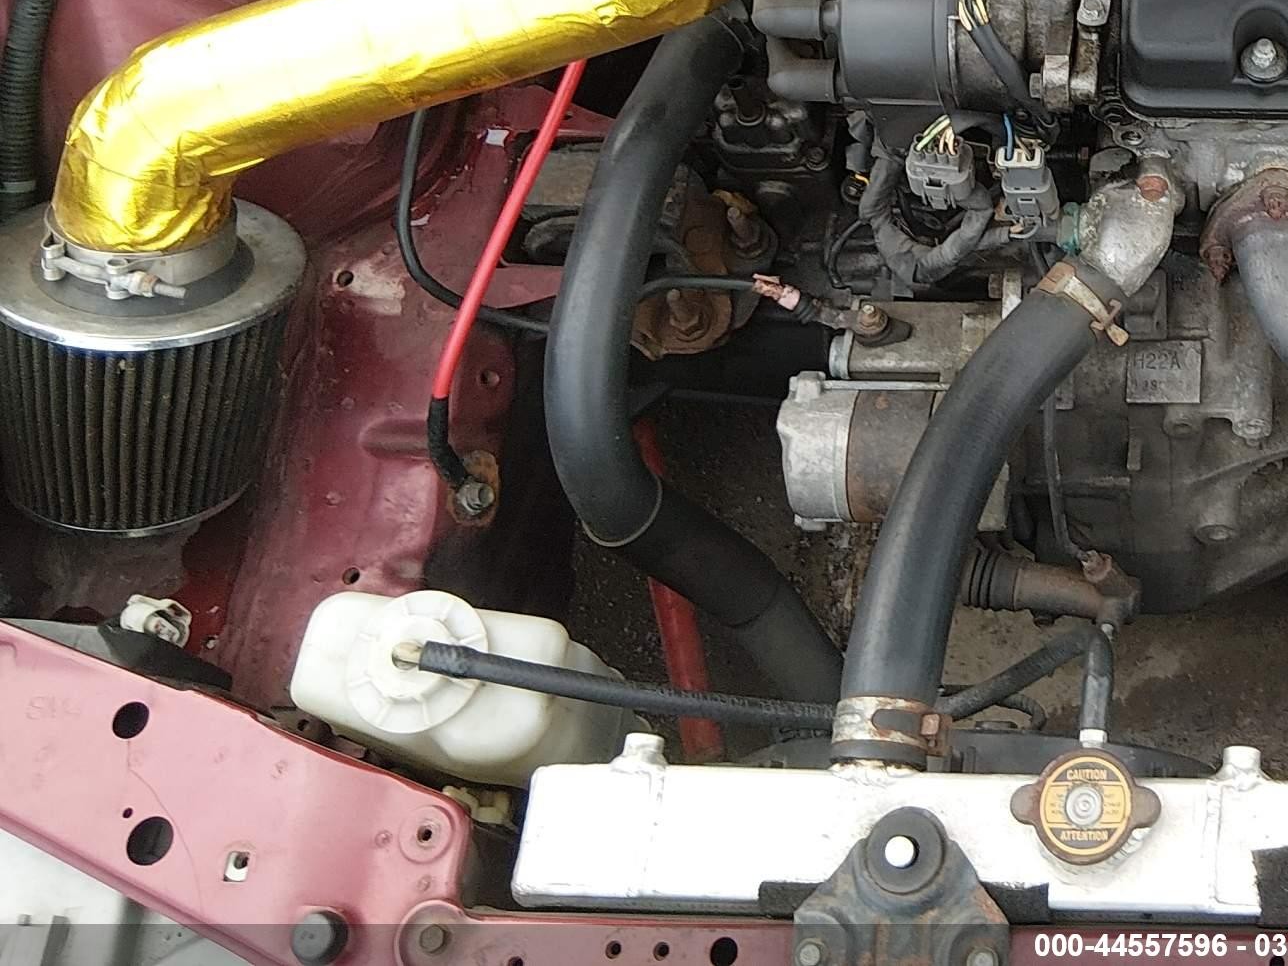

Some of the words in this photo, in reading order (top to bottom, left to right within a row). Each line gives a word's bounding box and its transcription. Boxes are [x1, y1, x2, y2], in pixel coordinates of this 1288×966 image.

[1133, 351, 1182, 371] H22A
[1066, 768, 1108, 781] CAUTION
[1062, 831, 1108, 841] ATTENTION
